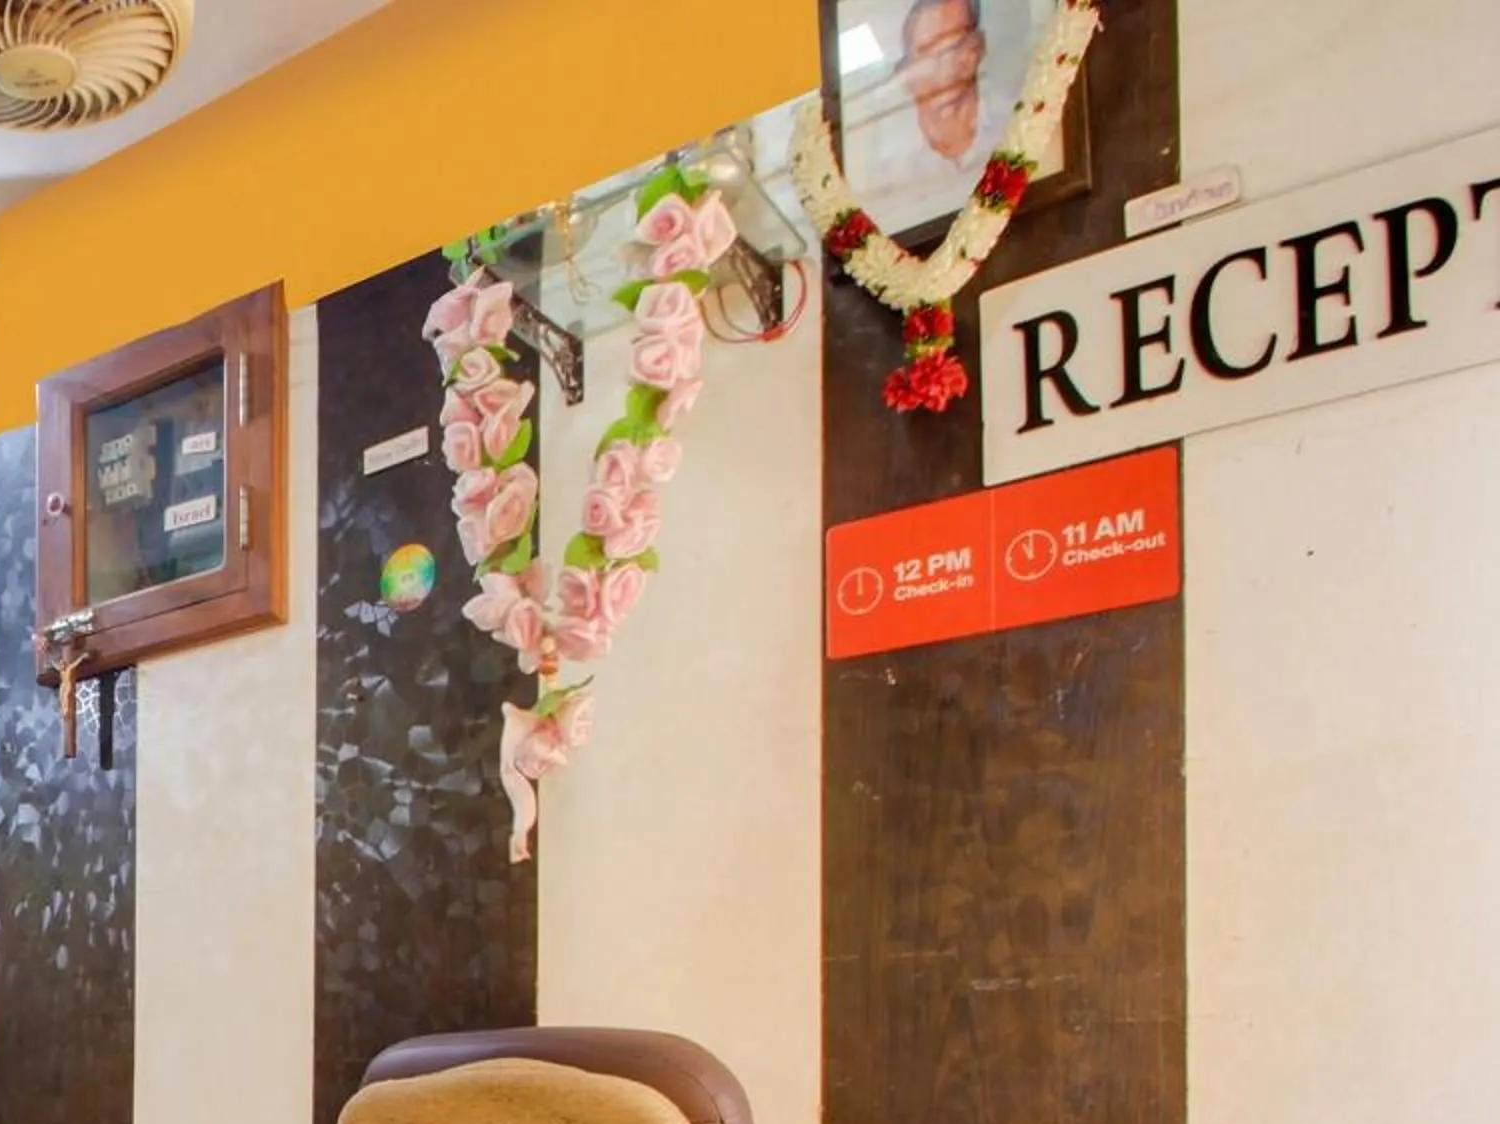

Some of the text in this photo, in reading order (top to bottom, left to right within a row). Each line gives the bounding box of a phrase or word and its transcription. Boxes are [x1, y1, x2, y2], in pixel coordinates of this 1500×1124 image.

[1061, 509, 1146, 547] 11 AM
[893, 547, 973, 583] 12 PM
[1061, 532, 1167, 567] Check-out
[893, 574, 975, 602] Check-in
